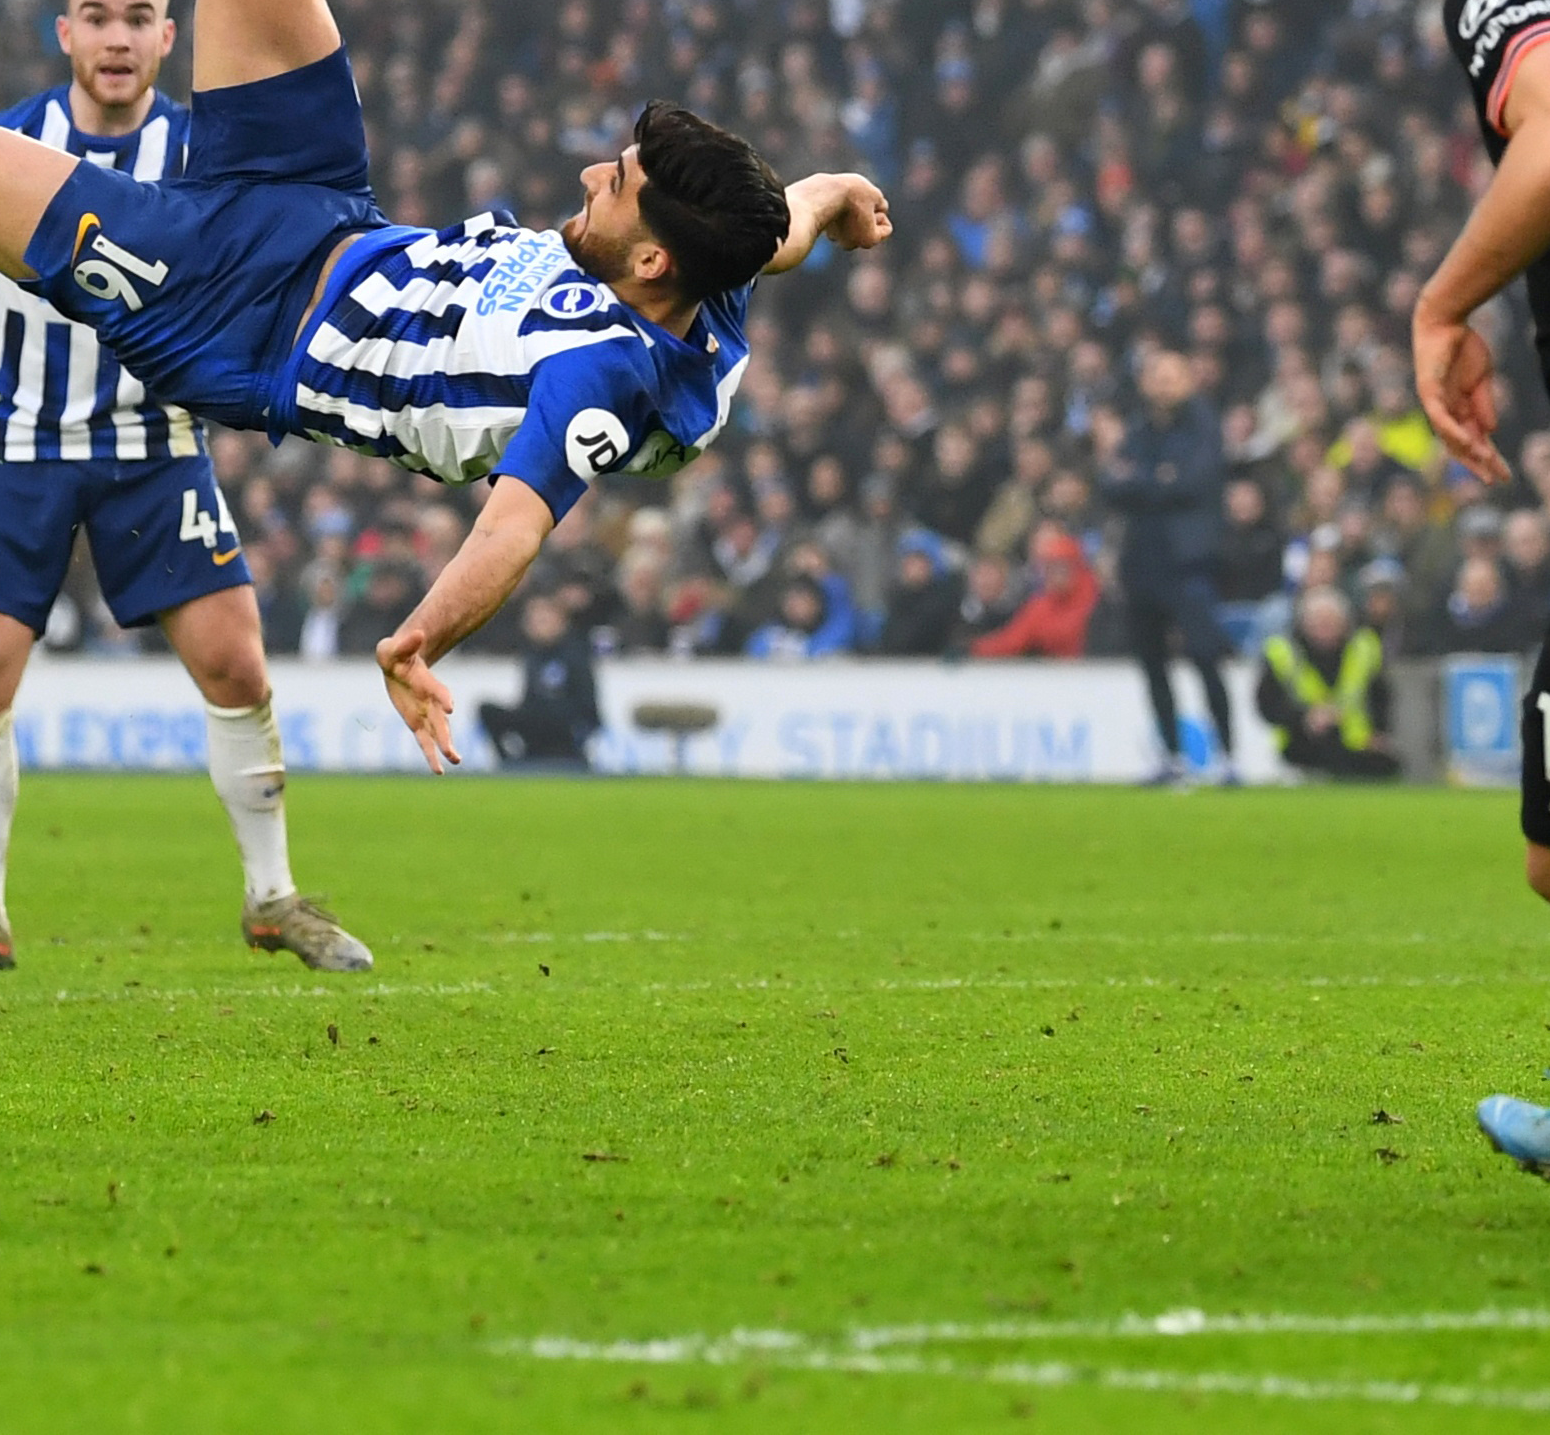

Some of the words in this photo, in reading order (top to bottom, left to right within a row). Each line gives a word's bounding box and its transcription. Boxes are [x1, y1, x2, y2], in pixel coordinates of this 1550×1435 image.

[73, 233, 169, 312] 16
[476, 231, 554, 317] XPRESS
[575, 430, 618, 472] JD
[776, 710, 1092, 777] STADIUM
